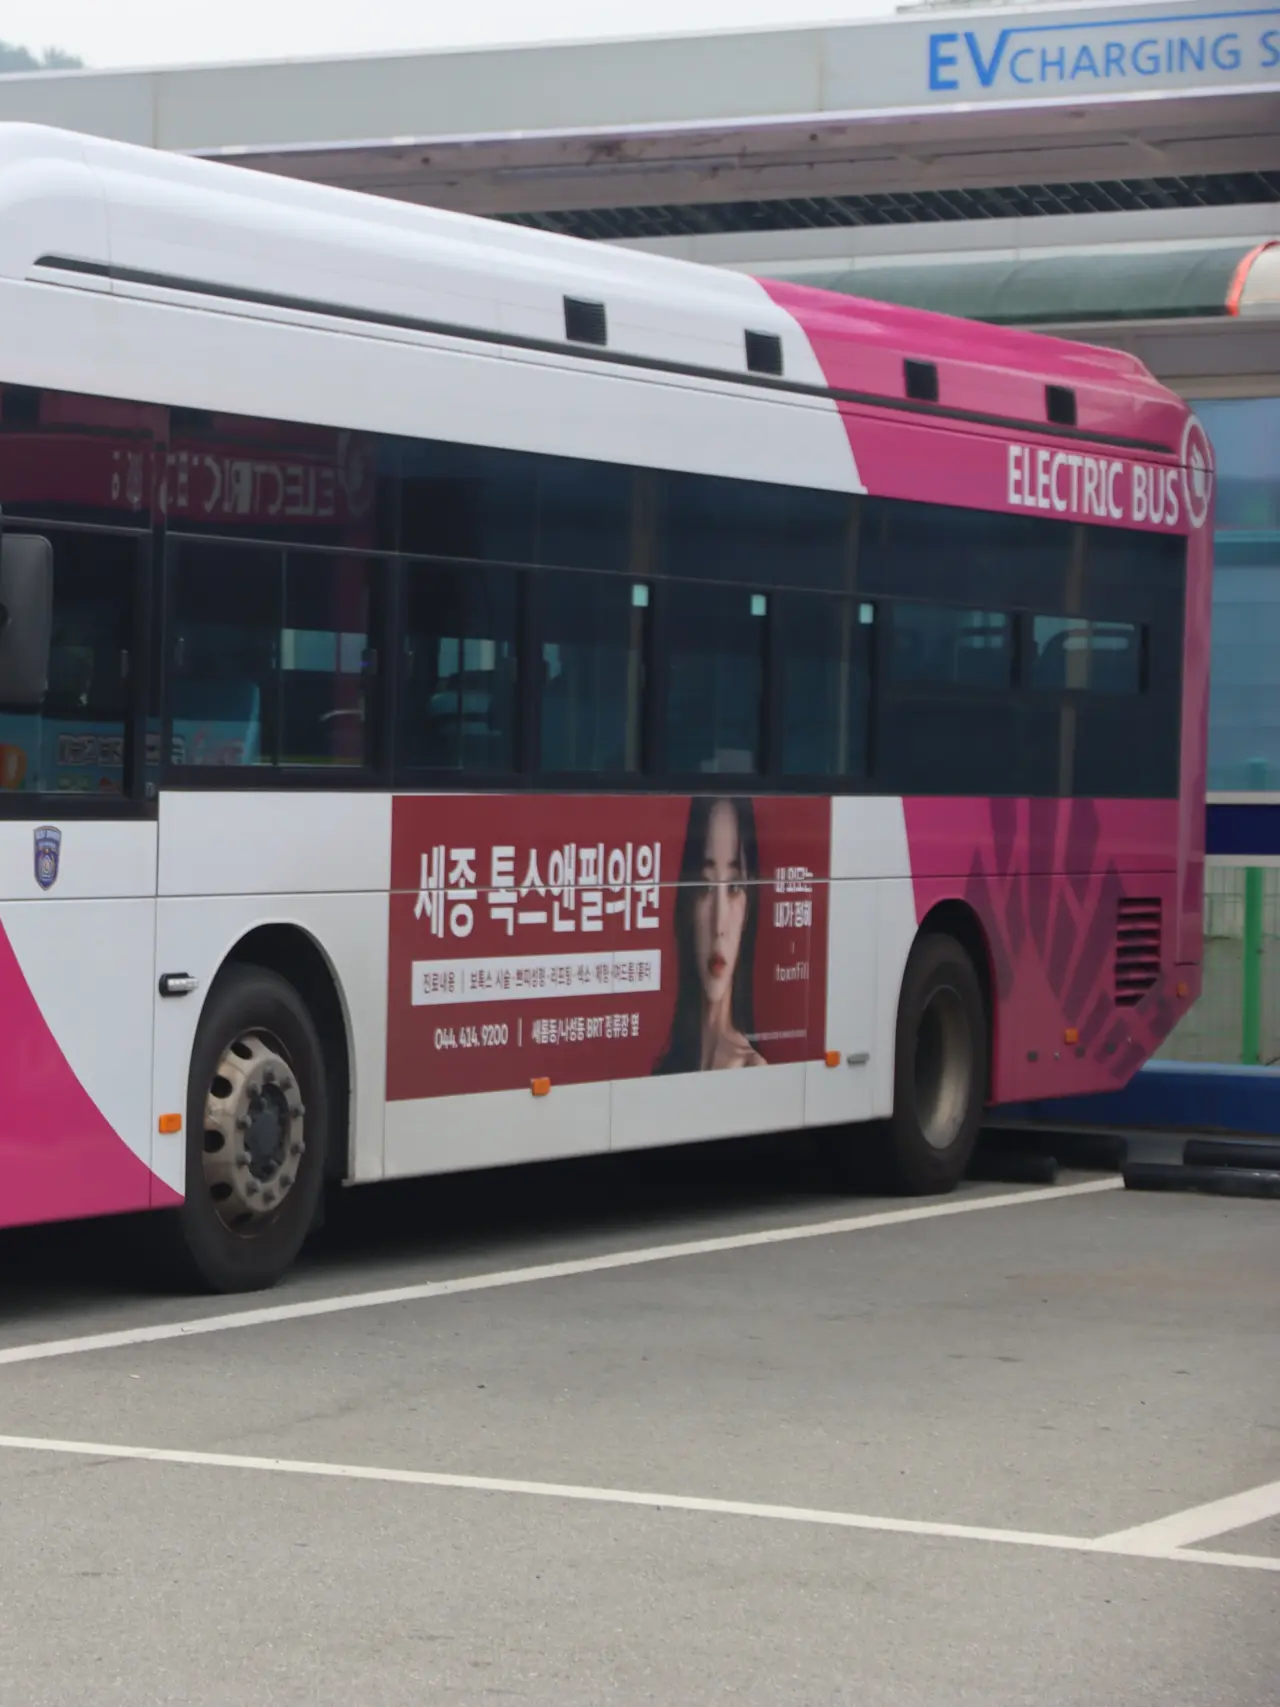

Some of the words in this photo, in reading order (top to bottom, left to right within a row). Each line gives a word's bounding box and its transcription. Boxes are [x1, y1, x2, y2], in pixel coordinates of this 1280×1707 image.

[1007, 445, 1124, 517] ELECTRIC
[1131, 465, 1180, 527] BUS
[414, 844, 478, 940] 세종
[487, 842, 661, 936] 톡스앤필의원
